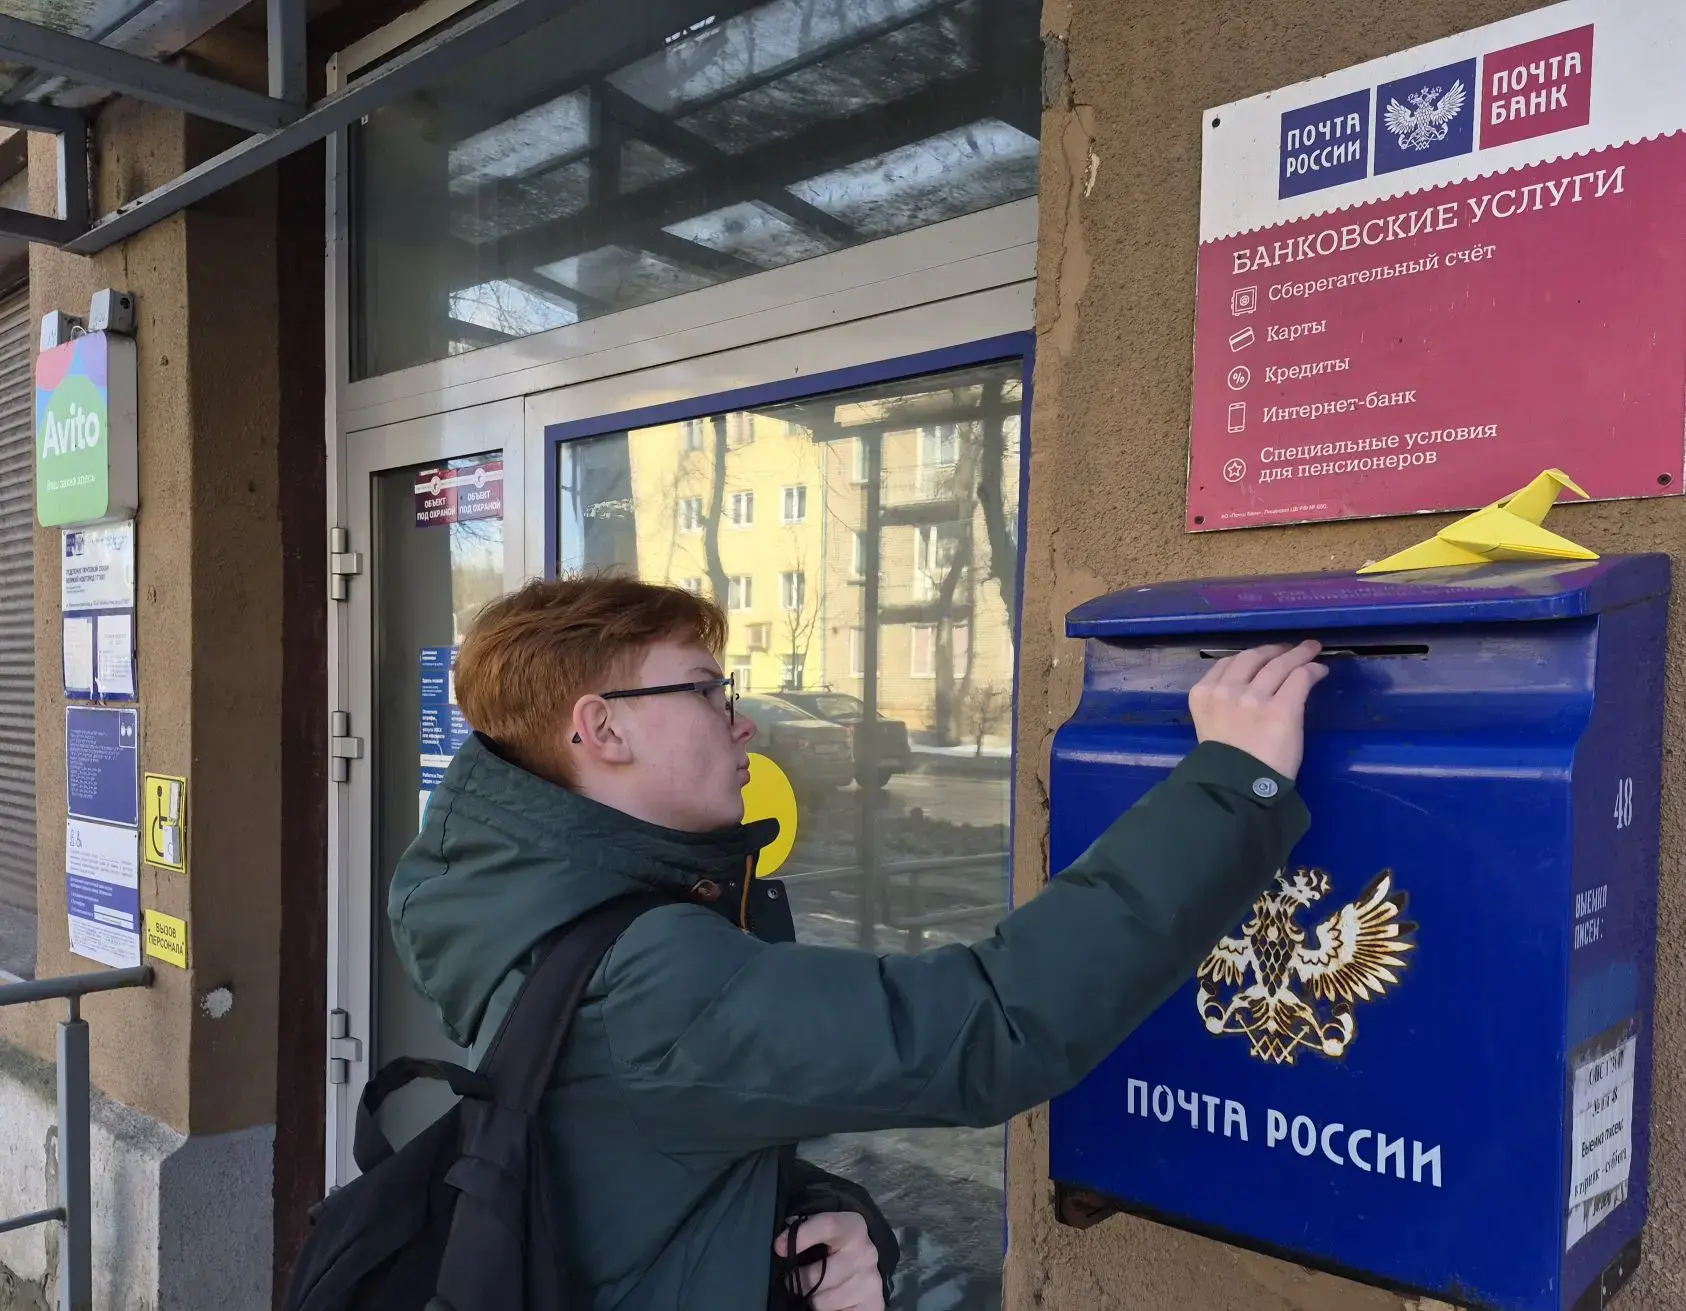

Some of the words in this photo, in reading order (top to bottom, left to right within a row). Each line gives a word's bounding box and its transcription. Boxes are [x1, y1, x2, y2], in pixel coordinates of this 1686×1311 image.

[1492, 51, 1582, 97] ПОЧТА
[1491, 84, 1568, 125] БАНК
[1287, 112, 1361, 151] ПОЧТА
[1286, 138, 1361, 177] РОССИИ
[1232, 201, 1459, 275] БАНКОВСКИЕ
[1467, 165, 1626, 226] УСЛУГИ
[1268, 254, 1440, 301] Сберегательный
[1445, 243, 1497, 267] счёт
[1266, 320, 1328, 344] Карты
[1264, 357, 1350, 383] Кредиты
[1263, 388, 1417, 423] Интернет-банк
[42, 402, 100, 460] Avito
[1260, 432, 1400, 464] Специальные
[1405, 424, 1498, 449] условия
[1258, 466, 1293, 484] для
[1297, 449, 1438, 478] пенсионеров
[416, 511, 429, 521] ПОД
[429, 506, 456, 518] ОХРАНОЙ
[424, 498, 446, 508] ОБЪЕКТ
[459, 505, 472, 515] ПОД
[472, 499, 501, 512] ОХРАНОЙ
[467, 490, 491, 501] ОБЪЕКТ
[1613, 776, 1633, 830] 48
[148, 934, 184, 956] ПЕРСОНАЛА
[155, 922, 177, 939] ВЫЗОВ
[1127, 1078, 1248, 1142] ПОЧТА
[1266, 1108, 1442, 1188] РОССИИ
